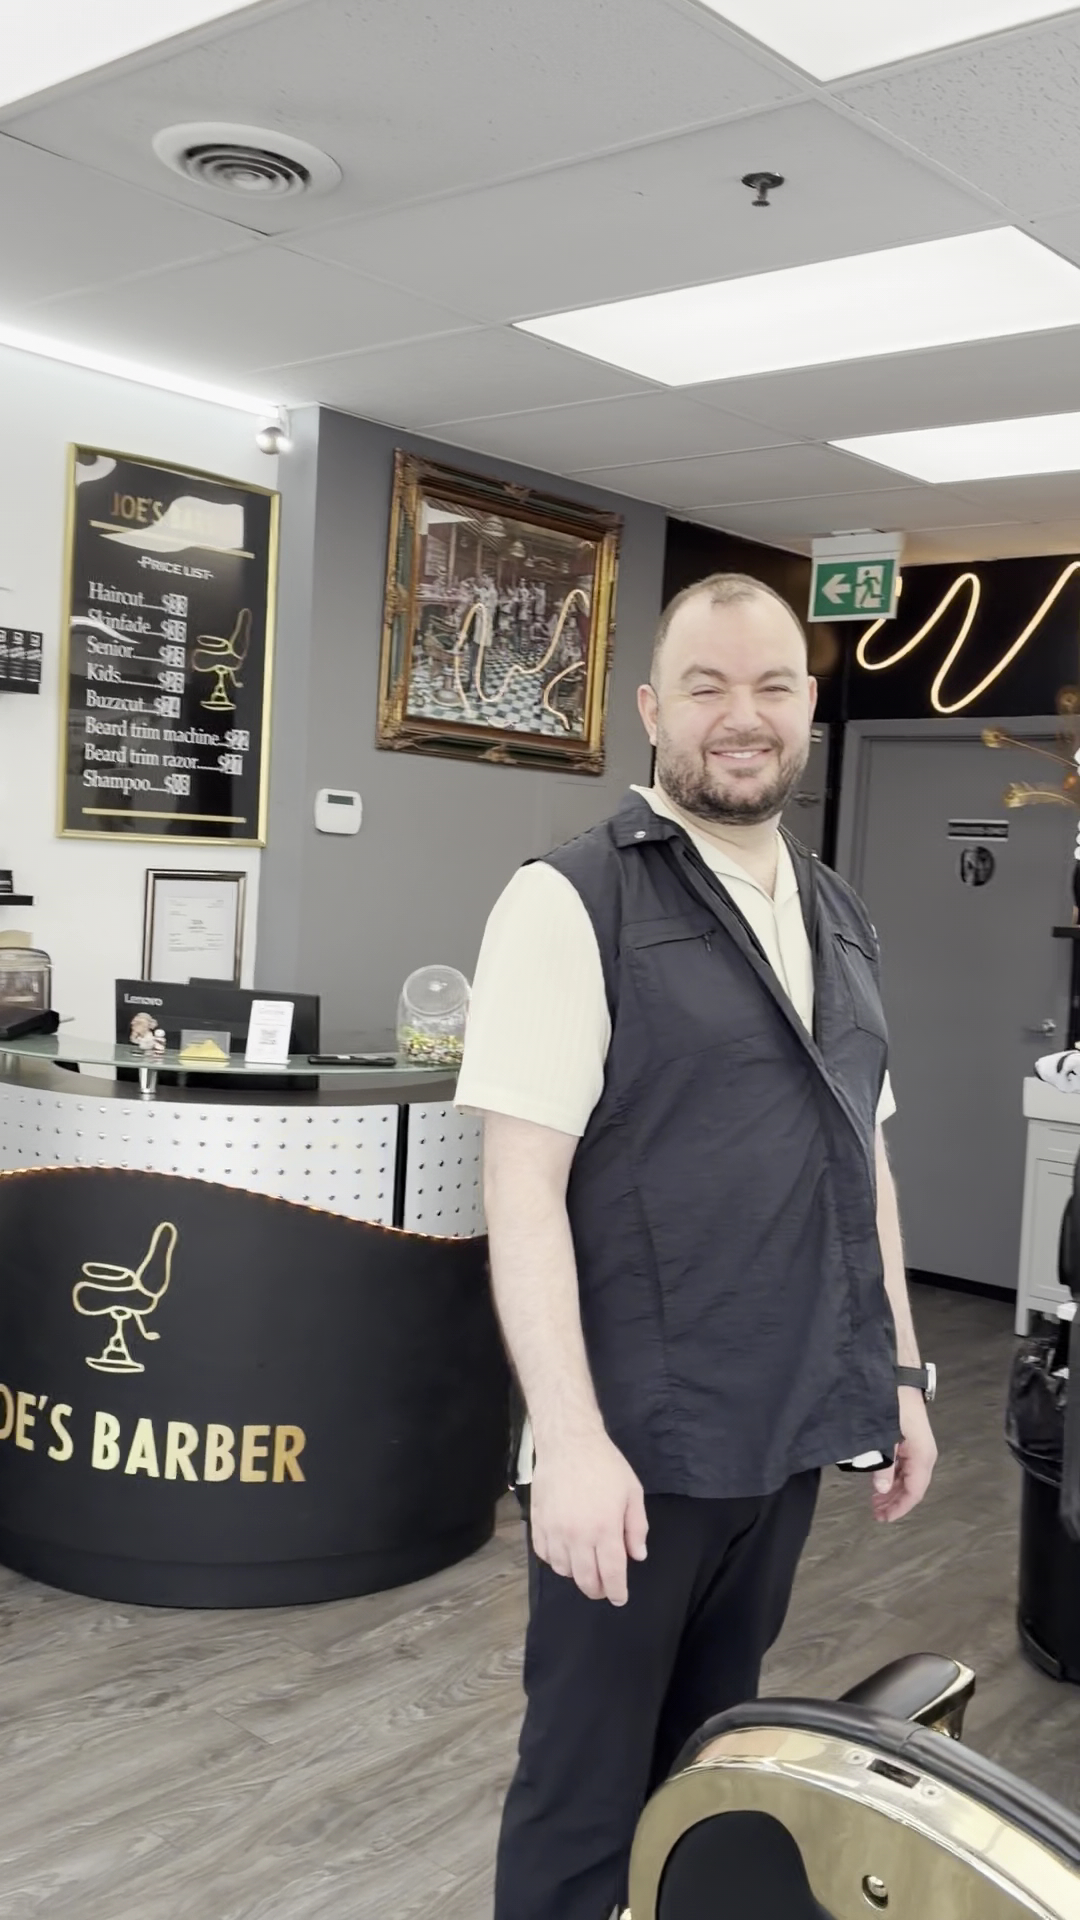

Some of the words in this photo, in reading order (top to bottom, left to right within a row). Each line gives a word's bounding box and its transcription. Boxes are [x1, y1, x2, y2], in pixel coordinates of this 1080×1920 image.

[88, 581, 145, 607] Haircut
[87, 635, 135, 658] Senior
[86, 662, 122, 684] Kids
[86, 688, 145, 713] Buzzcut
[85, 716, 127, 737] Beard
[130, 722, 160, 741] trim
[163, 727, 220, 746] machine
[84, 743, 127, 764] Beard
[130, 748, 160, 766] trim
[162, 754, 199, 770] razor
[83, 769, 151, 796] Shampoo
[91, 1411, 307, 1482] BARBER
